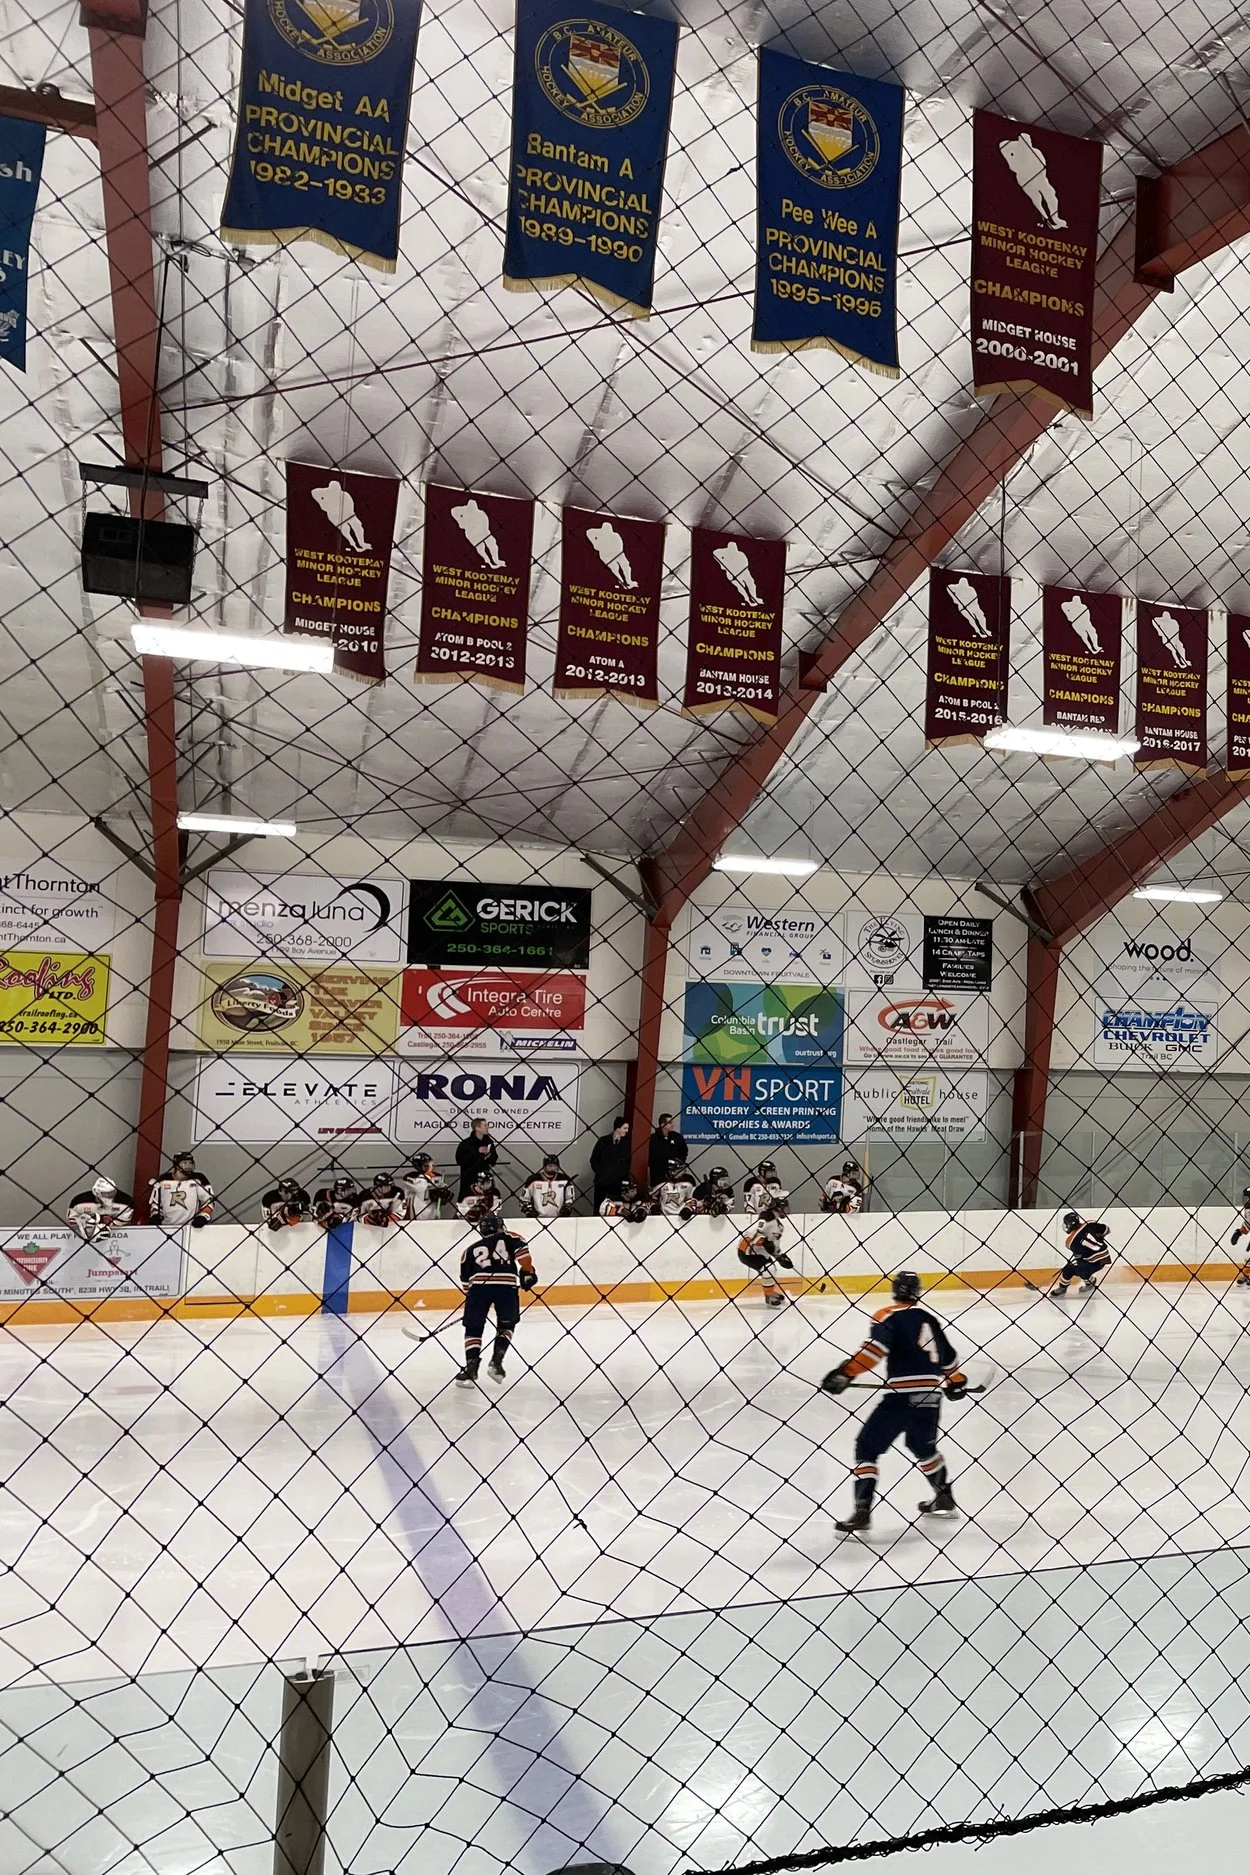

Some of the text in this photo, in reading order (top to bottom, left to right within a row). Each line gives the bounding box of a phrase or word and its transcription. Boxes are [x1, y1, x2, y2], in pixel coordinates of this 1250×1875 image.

[316, 26, 387, 60] ASSOCIATION
[258, 69, 389, 123] Midget AA
[581, 91, 644, 124] ASSOCIATION
[246, 104, 399, 155] PROVINCIAL
[248, 132, 396, 180] CHAMPIONS
[527, 133, 634, 180] Bantam A
[821, 150, 874, 185] ASSOCIATION
[781, 198, 877, 240] Pee Wee A
[519, 215, 643, 263] 1989-1990
[977, 220, 1087, 257] WEST KOOTENAY
[765, 228, 887, 272] PROVINCIAL
[980, 235, 1084, 270] MINOR HOCKEY
[768, 252, 885, 294] CHAMPIONS
[1006, 256, 1058, 278] LEAGUE
[770, 277, 882, 318] 1995-1996
[974, 279, 1085, 318] CHAMPIONS
[982, 318, 1077, 350] MIDGET HOUSE
[975, 338, 1079, 376] 2000-2001
[294, 547, 385, 568] WEST KOOTENAY
[297, 559, 381, 578] MINOR HOCKEY
[433, 564, 520, 585] WEST KOOTENAY
[317, 574, 361, 587] LEAGUE
[435, 576, 470, 589] MINOR
[292, 591, 381, 612] CHAMPIONS
[455, 589, 497, 603] LEAGUE
[569, 584, 651, 605] WEST KOOTENAY
[571, 596, 647, 615] MINOR HOCKEY
[726, 608, 775, 620] KOOTENAY
[295, 617, 375, 636] MIDGET HOUSE
[431, 606, 518, 629] CHAMPIONS
[701, 614, 773, 630] MINOR HOCKEY
[435, 632, 504, 650] ATOM B POOL
[567, 625, 649, 647] CHAMPIONS
[430, 647, 515, 669] 2012-2013
[696, 643, 774, 661] CHAMPIONS
[589, 656, 624, 668] ATOM A
[565, 665, 645, 687] 2012-2013
[699, 668, 769, 684] BANTAM HOUSE
[934, 672, 1005, 691] CHAMPIONS
[962, 699, 969, 707] B
[1049, 689, 1114, 705] CHAMPIONS
[1056, 711, 1088, 722] BANTAM
[1141, 702, 1201, 718] CHAMPIONS
[31, 904, 99, 919] for growth
[476, 898, 577, 923] GERICK
[480, 923, 534, 935] SPORTS
[747, 916, 815, 931] Western
[256, 934, 352, 947] 250-368-2000
[447, 944, 553, 956] 250-364-1661
[1123, 938, 1194, 962] wood.
[49, 991, 76, 1000] LTD.
[468, 987, 563, 1006] Integra Tire
[227, 999, 294, 1016] Liberty Foods
[488, 1006, 561, 1017] Auto Centre
[711, 1012, 819, 1037] Columbia trust
[890, 1012, 957, 1030] A&W
[1103, 1006, 1209, 1030] CHAMPION
[729, 1025, 755, 1035] Basin
[1103, 1030, 1211, 1043] CHEVROLET
[514, 1039, 574, 1048] MICHELIN
[886, 1037, 927, 1046] Castlegar
[1166, 1044, 1202, 1052] GMC
[242, 1082, 377, 1097] ELEVATE
[416, 1074, 562, 1101] RONA
[692, 1067, 834, 1101] VH SPORT
[854, 1089, 978, 1100] public house
[904, 1096, 930, 1105] HOTEL
[686, 1106, 837, 1116] EMBROIDERY SCREEN PRINTING
[889, 1116, 905, 1124] good
[712, 1120, 811, 1129] TROPHIES & AWARDS
[473, 1239, 511, 1268] 24
[87, 1269, 138, 1278] Jumpstart
